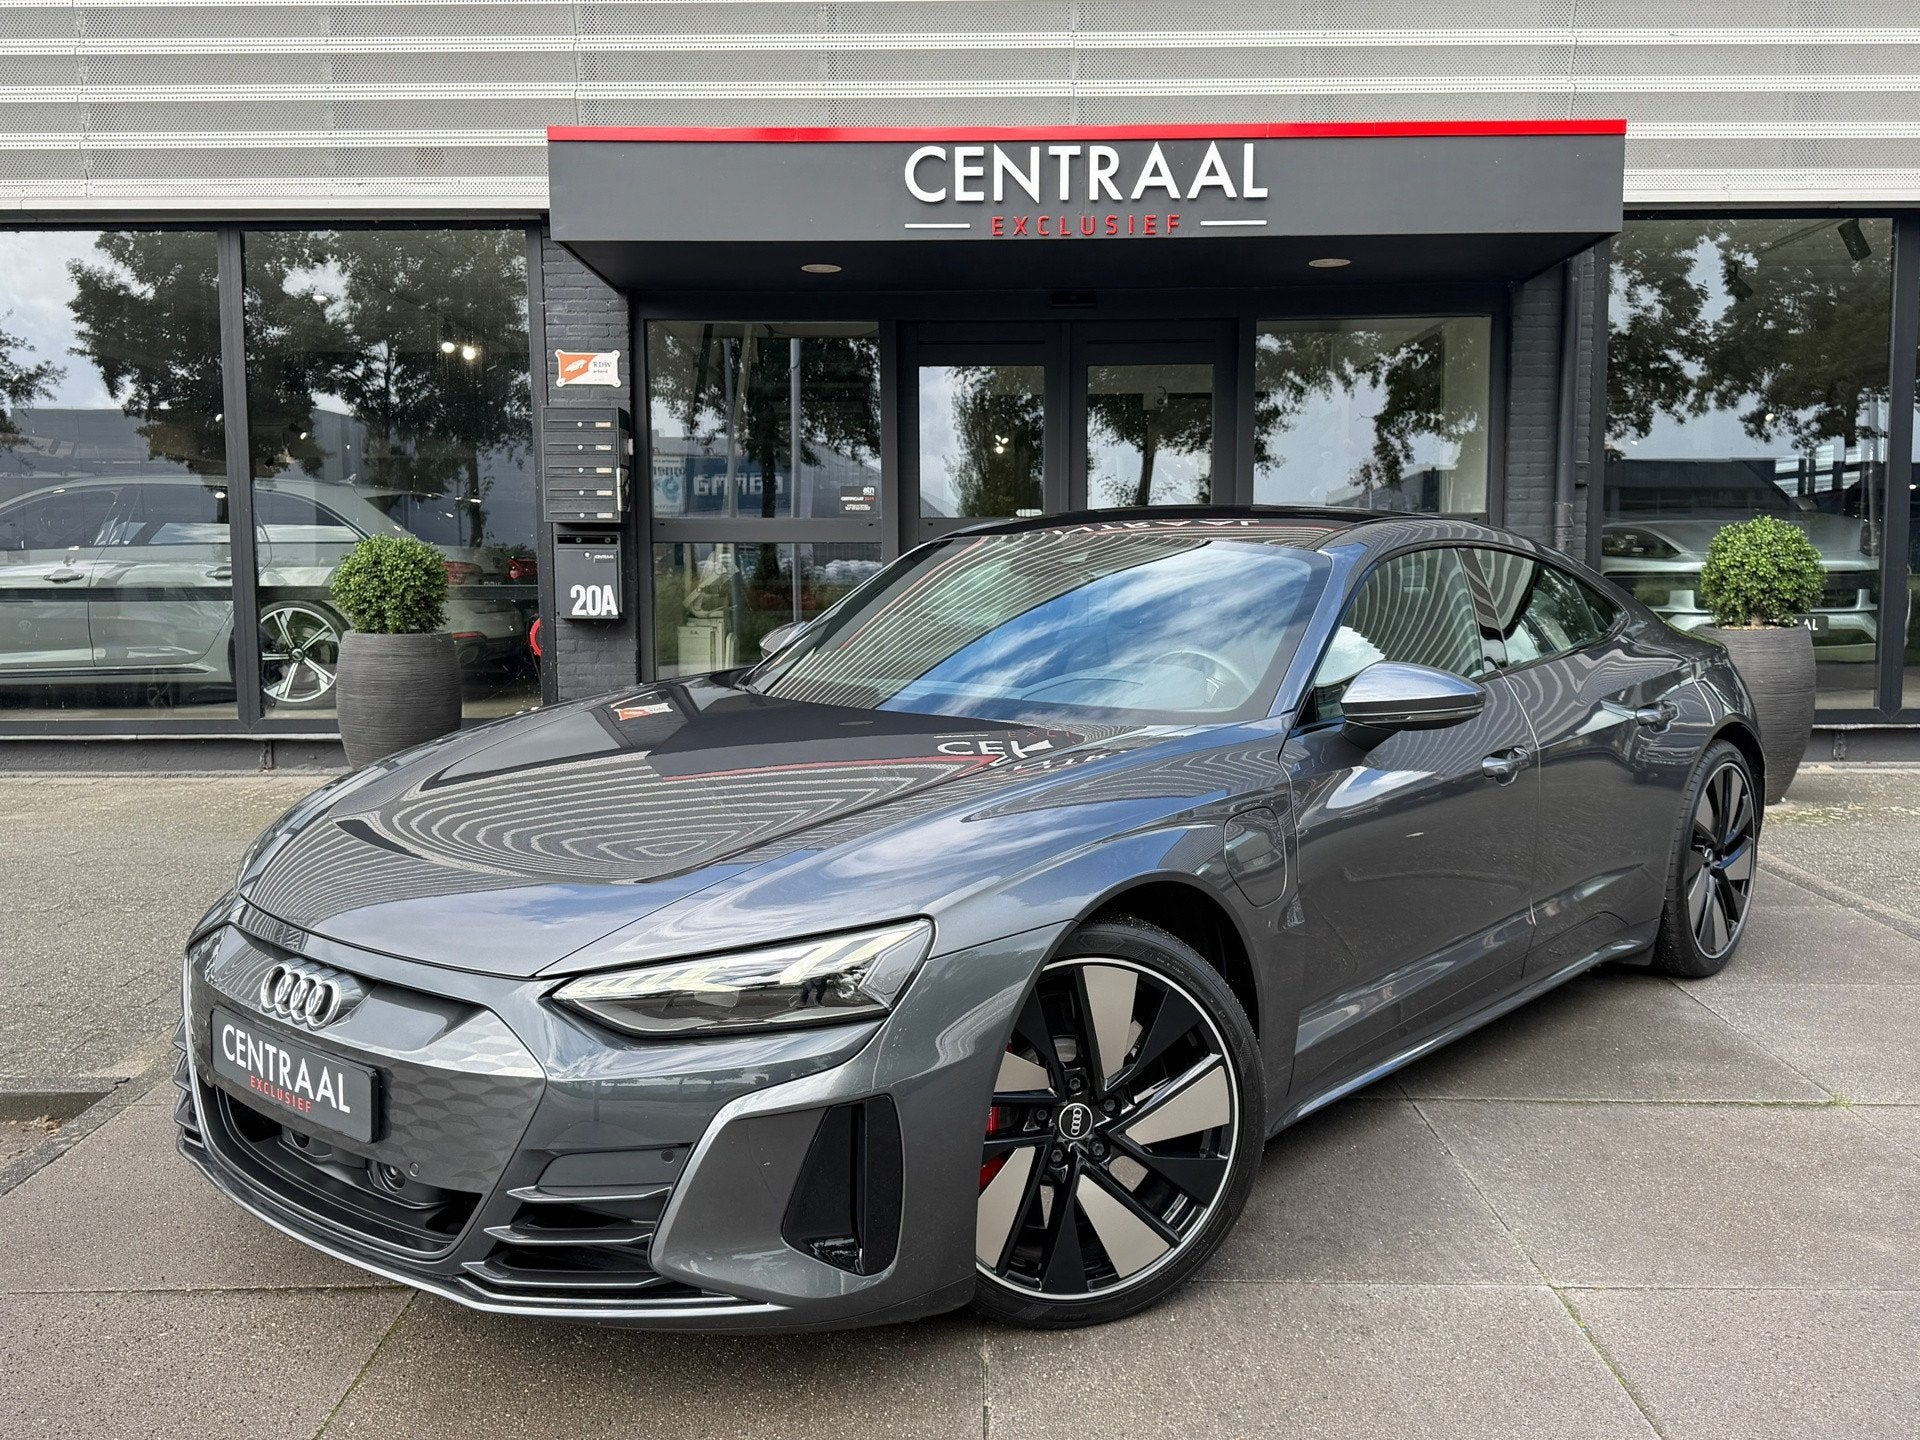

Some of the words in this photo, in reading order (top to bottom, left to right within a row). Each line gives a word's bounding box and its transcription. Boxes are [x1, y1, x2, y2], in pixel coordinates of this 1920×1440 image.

[904, 141, 1269, 204] CENTRAAL
[991, 214, 1181, 236] EXCLUSIEF
[570, 584, 619, 616] 20A
[222, 1023, 351, 1114] CENTRAAL
[250, 1075, 313, 1114] EXCLUSIEF
